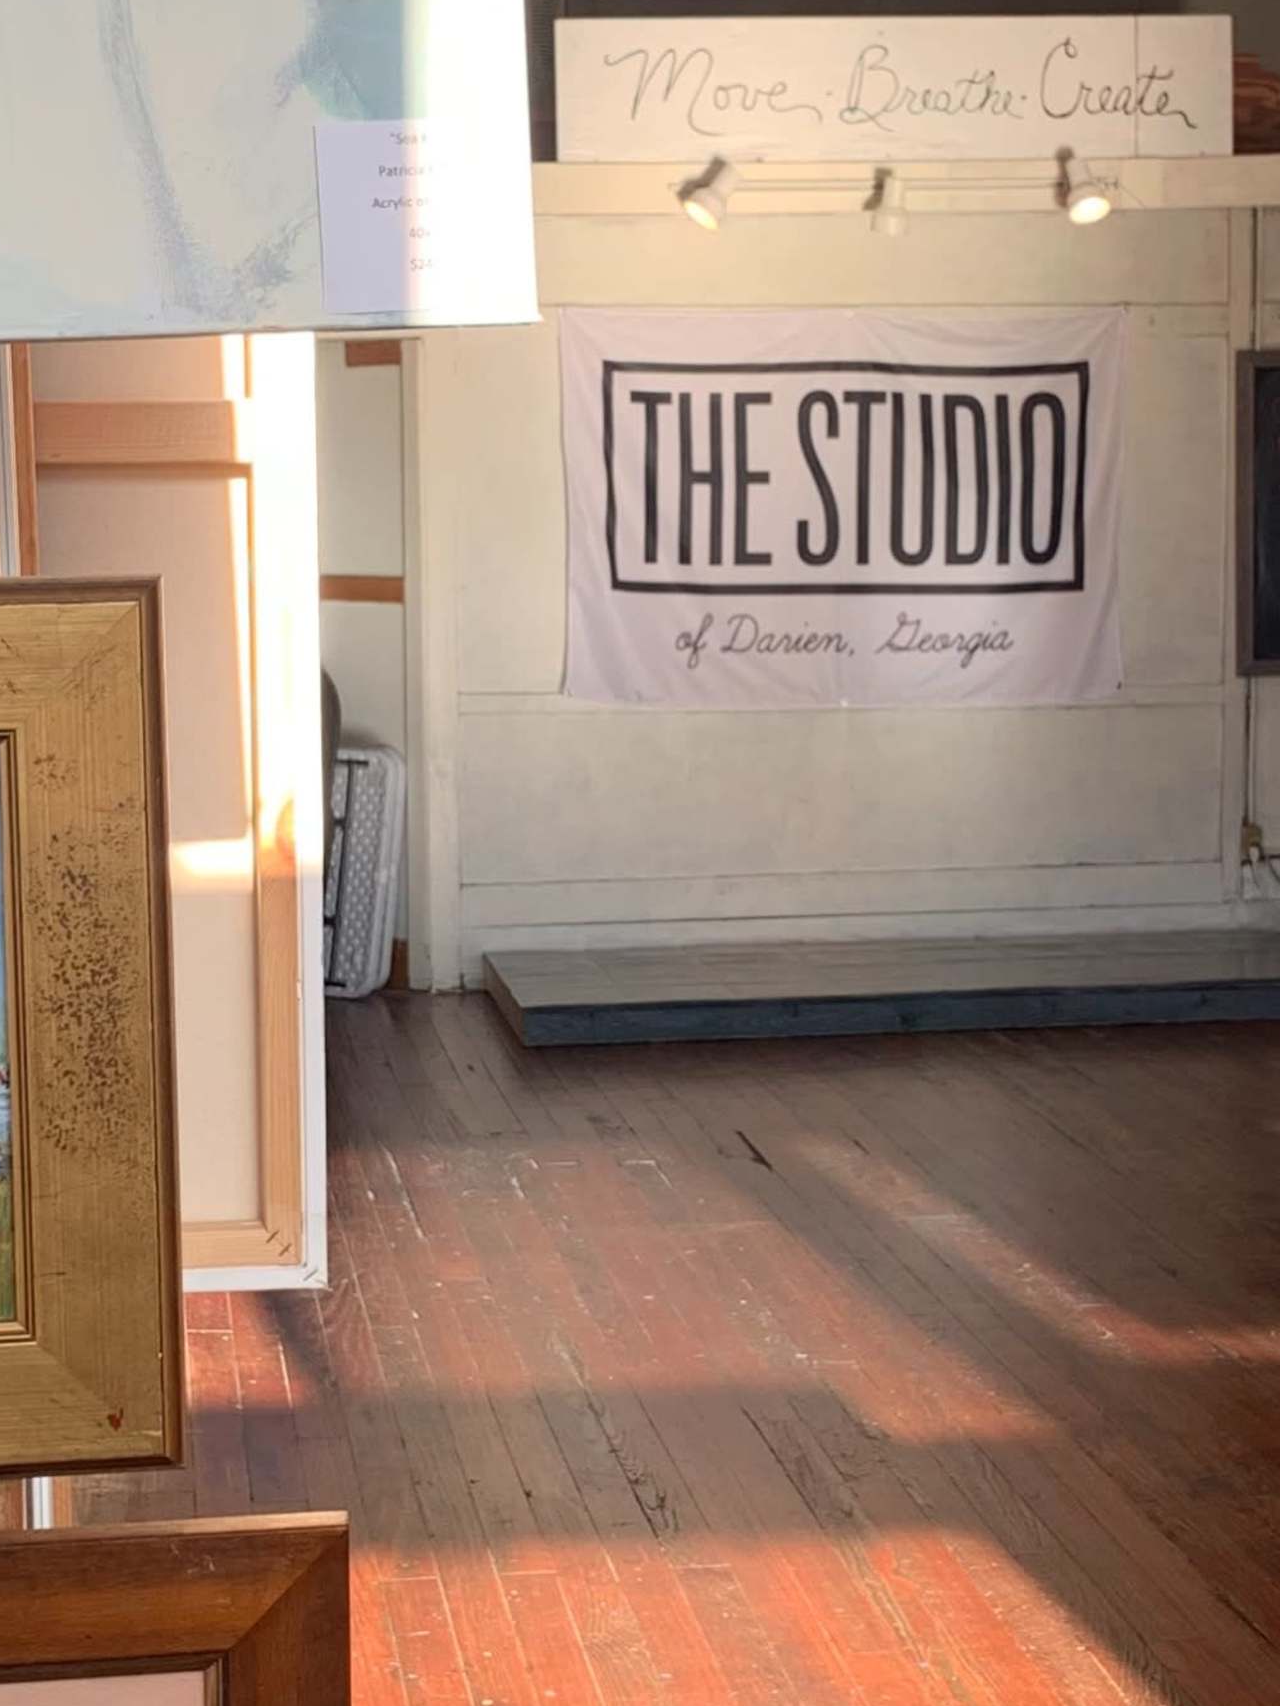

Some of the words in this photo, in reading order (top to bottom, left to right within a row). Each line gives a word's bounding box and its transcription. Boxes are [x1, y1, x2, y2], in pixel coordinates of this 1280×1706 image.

[603, 47, 822, 136] Move
[1040, 37, 1197, 129] Create
[630, 390, 773, 566] THE
[795, 389, 1066, 567] STUDIO
[675, 613, 715, 669] of
[874, 611, 1014, 669] Georgia
